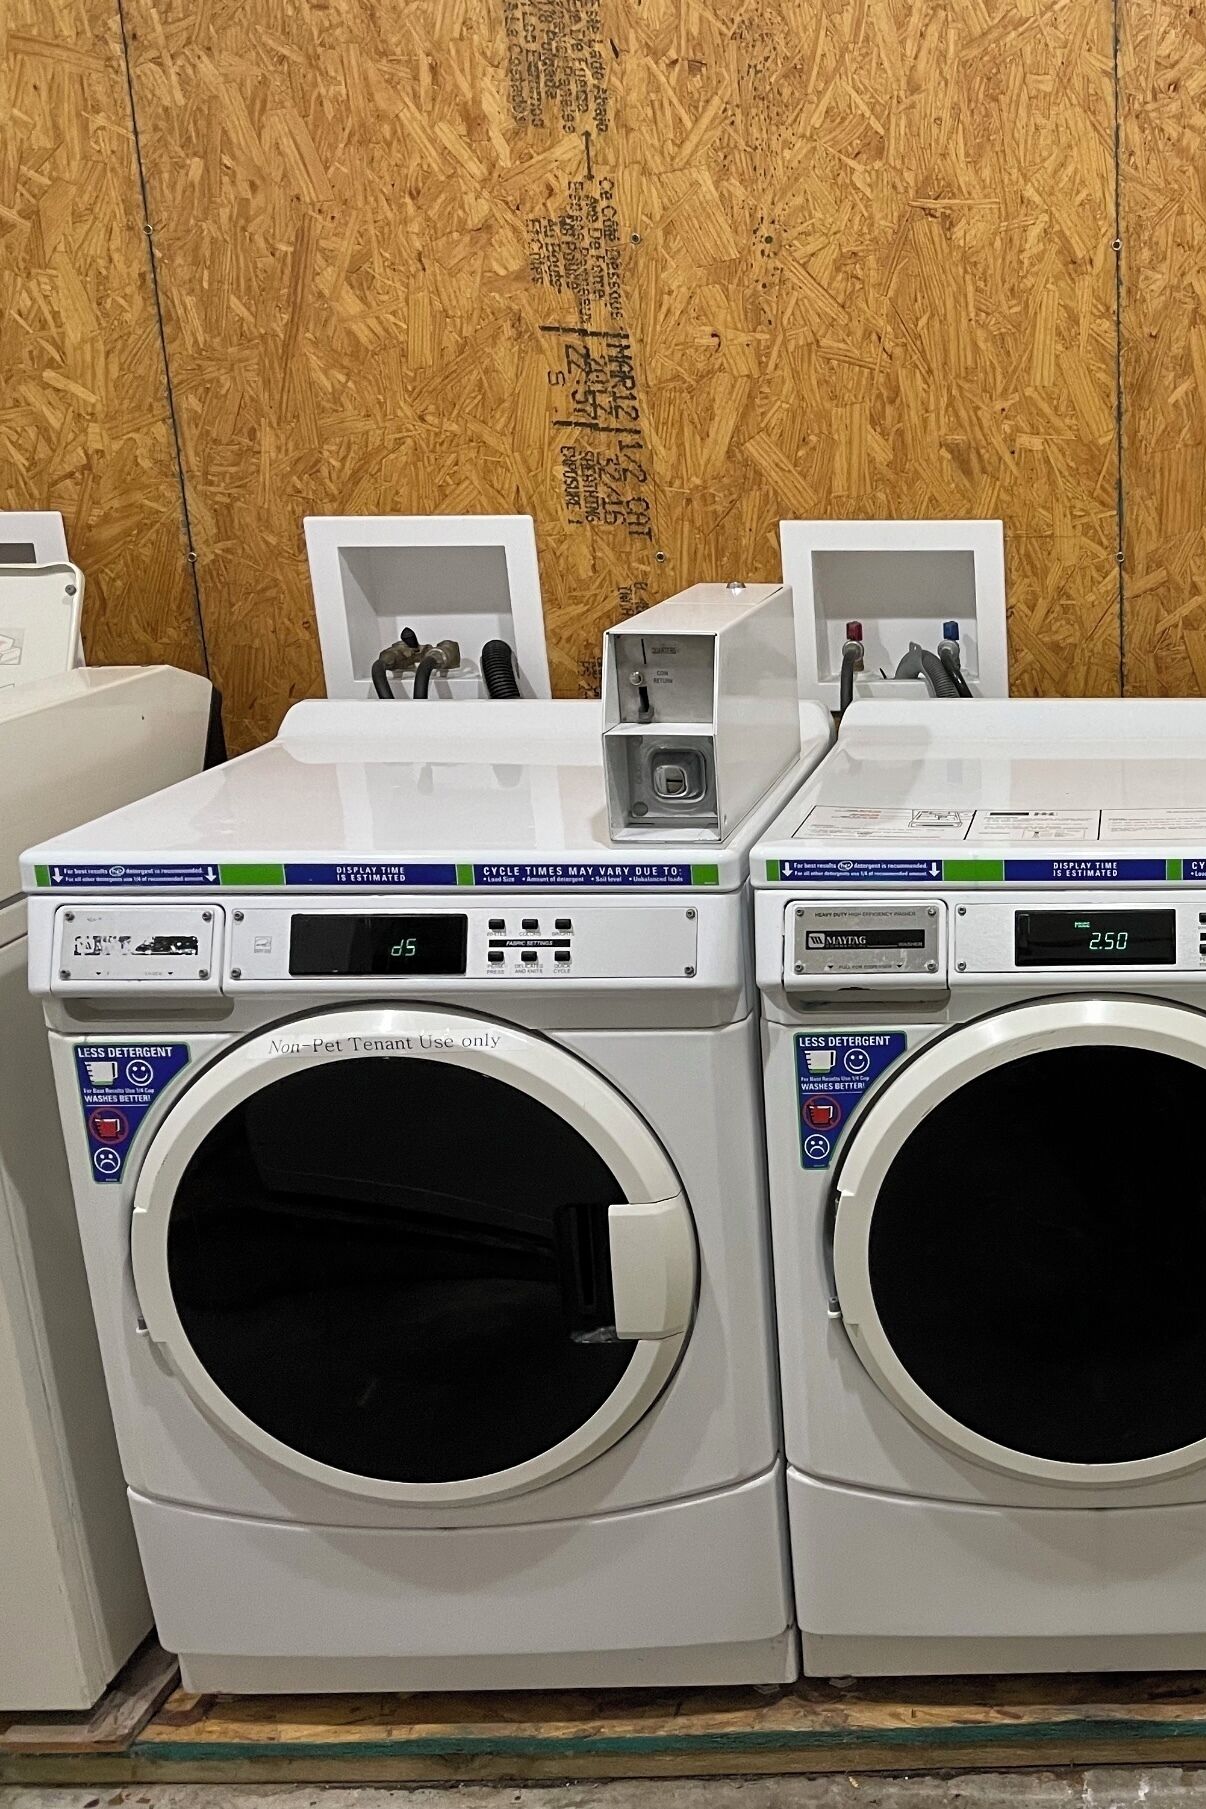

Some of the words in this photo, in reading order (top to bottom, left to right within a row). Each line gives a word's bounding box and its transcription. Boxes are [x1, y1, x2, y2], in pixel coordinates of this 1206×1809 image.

[560, 446, 581, 510] EXPOSURE
[580, 450, 600, 523] SHEATHING
[626, 497, 652, 542] CAT
[483, 867, 519, 875] CYCLE
[525, 867, 562, 875] TIMES
[568, 867, 593, 875] MAY
[600, 867, 629, 875] VARY
[635, 867, 658, 875] DUE
[825, 936, 867, 945] MAYTAG
[1089, 932, 1128, 950] 2.50
[268, 1038, 343, 1054] Non-Pet
[348, 1037, 413, 1051] Tenant
[419, 1035, 454, 1049] Use
[461, 1033, 501, 1049] only
[799, 1036, 825, 1046] LESS
[828, 1036, 891, 1046] DETERGENT
[77, 1047, 105, 1057] LESS
[108, 1047, 172, 1057] DETERGENT
